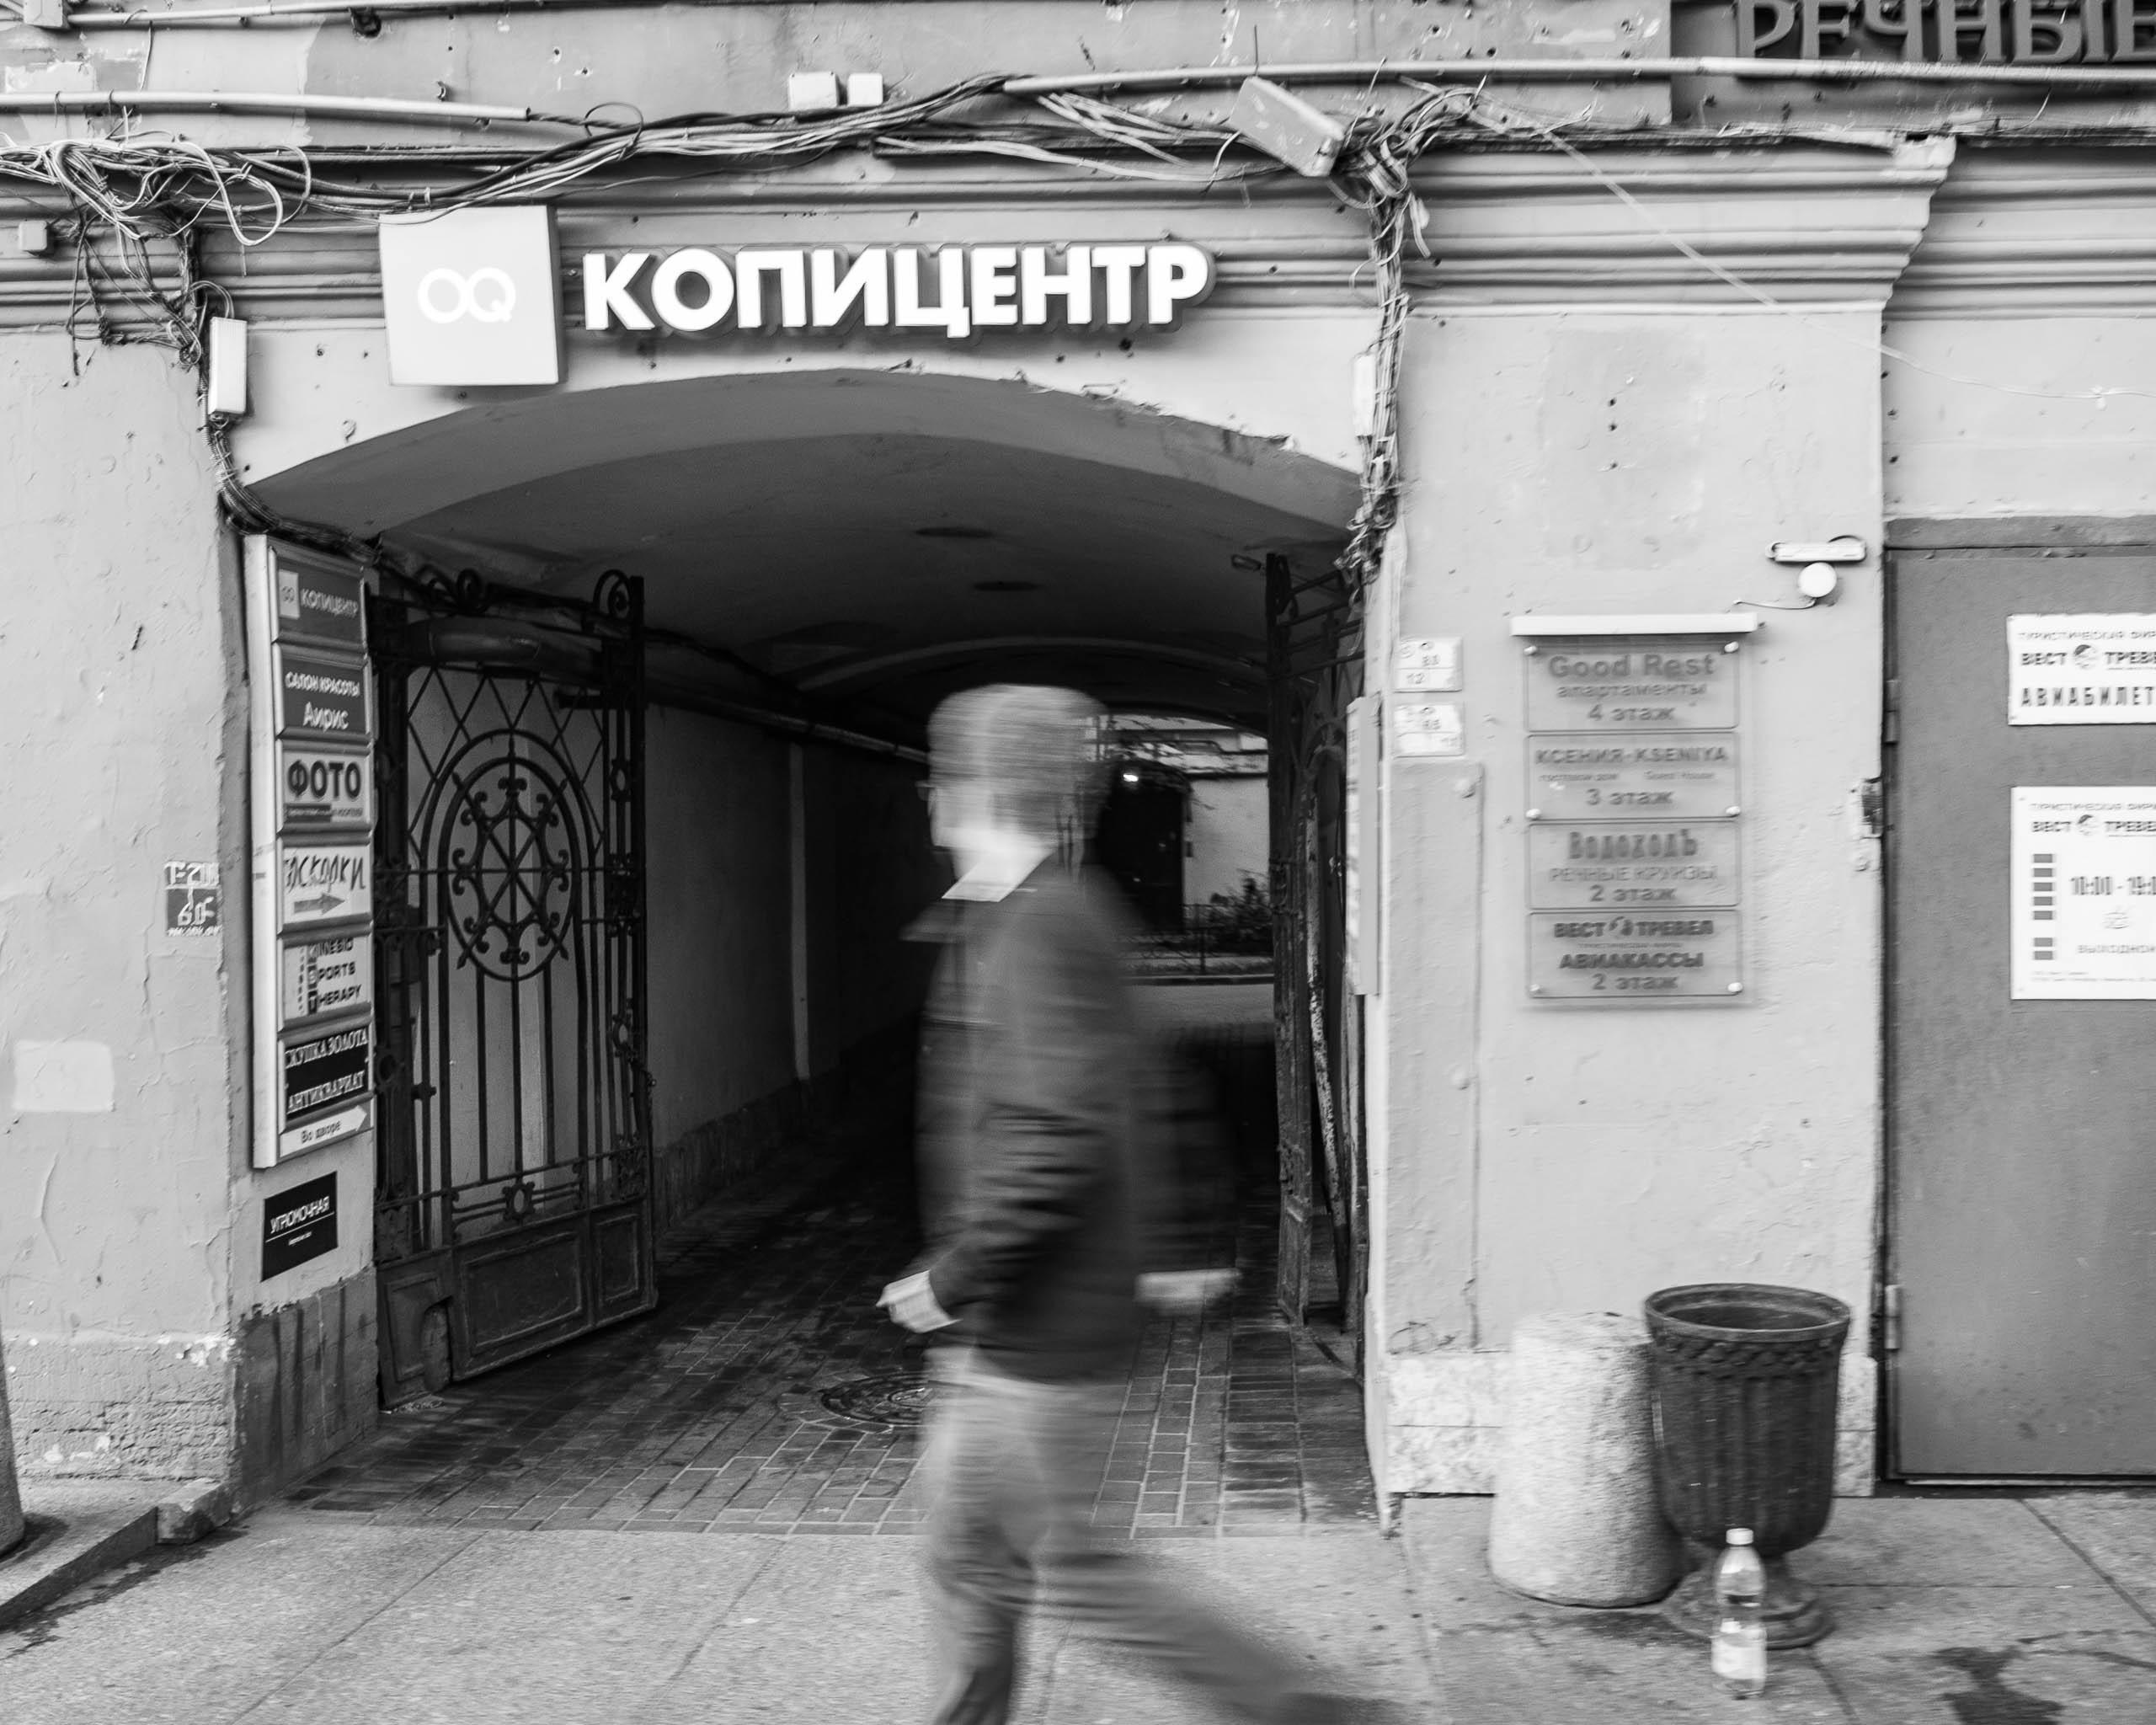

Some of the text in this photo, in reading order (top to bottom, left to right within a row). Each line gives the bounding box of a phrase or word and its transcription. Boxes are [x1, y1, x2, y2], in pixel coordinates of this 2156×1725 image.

[1737, 0, 2156, 64] РЕЧНЫЕ
[583, 244, 1214, 338] КОПИЦЕНТР
[300, 588, 359, 618] КОПИЦЕНТР
[1548, 654, 1716, 678] Good Rest
[2021, 651, 2156, 665] ВЕСТ ТРЕВ
[285, 670, 360, 697] САЛОН КРАСОТЫ
[1556, 683, 1708, 700] апартаменты
[303, 701, 350, 732] Аирис
[1588, 704, 1677, 723] 4 этаж
[287, 760, 362, 798] ФОТО
[1586, 788, 1674, 806] 3 этаж
[2032, 821, 2072, 833] ВЕСТ
[1549, 865, 1719, 883] РЕЧНЫЕ КРУИЗЫ
[1589, 884, 1678, 902] 2 этаж
[1553, 920, 1715, 938] ВЕСТ ТРЕВЕЛ
[1559, 952, 1705, 969] АВИАКАССЫ
[308, 961, 356, 985] SPORTS
[1592, 973, 1679, 991] 2 этаж
[309, 984, 362, 1011] THERAPY
[285, 1028, 368, 1069] СКУПКА ЗОЛОТА
[286, 1070, 365, 1114] АНТИКВАРИАТ
[302, 1121, 341, 1144] Во дворе
